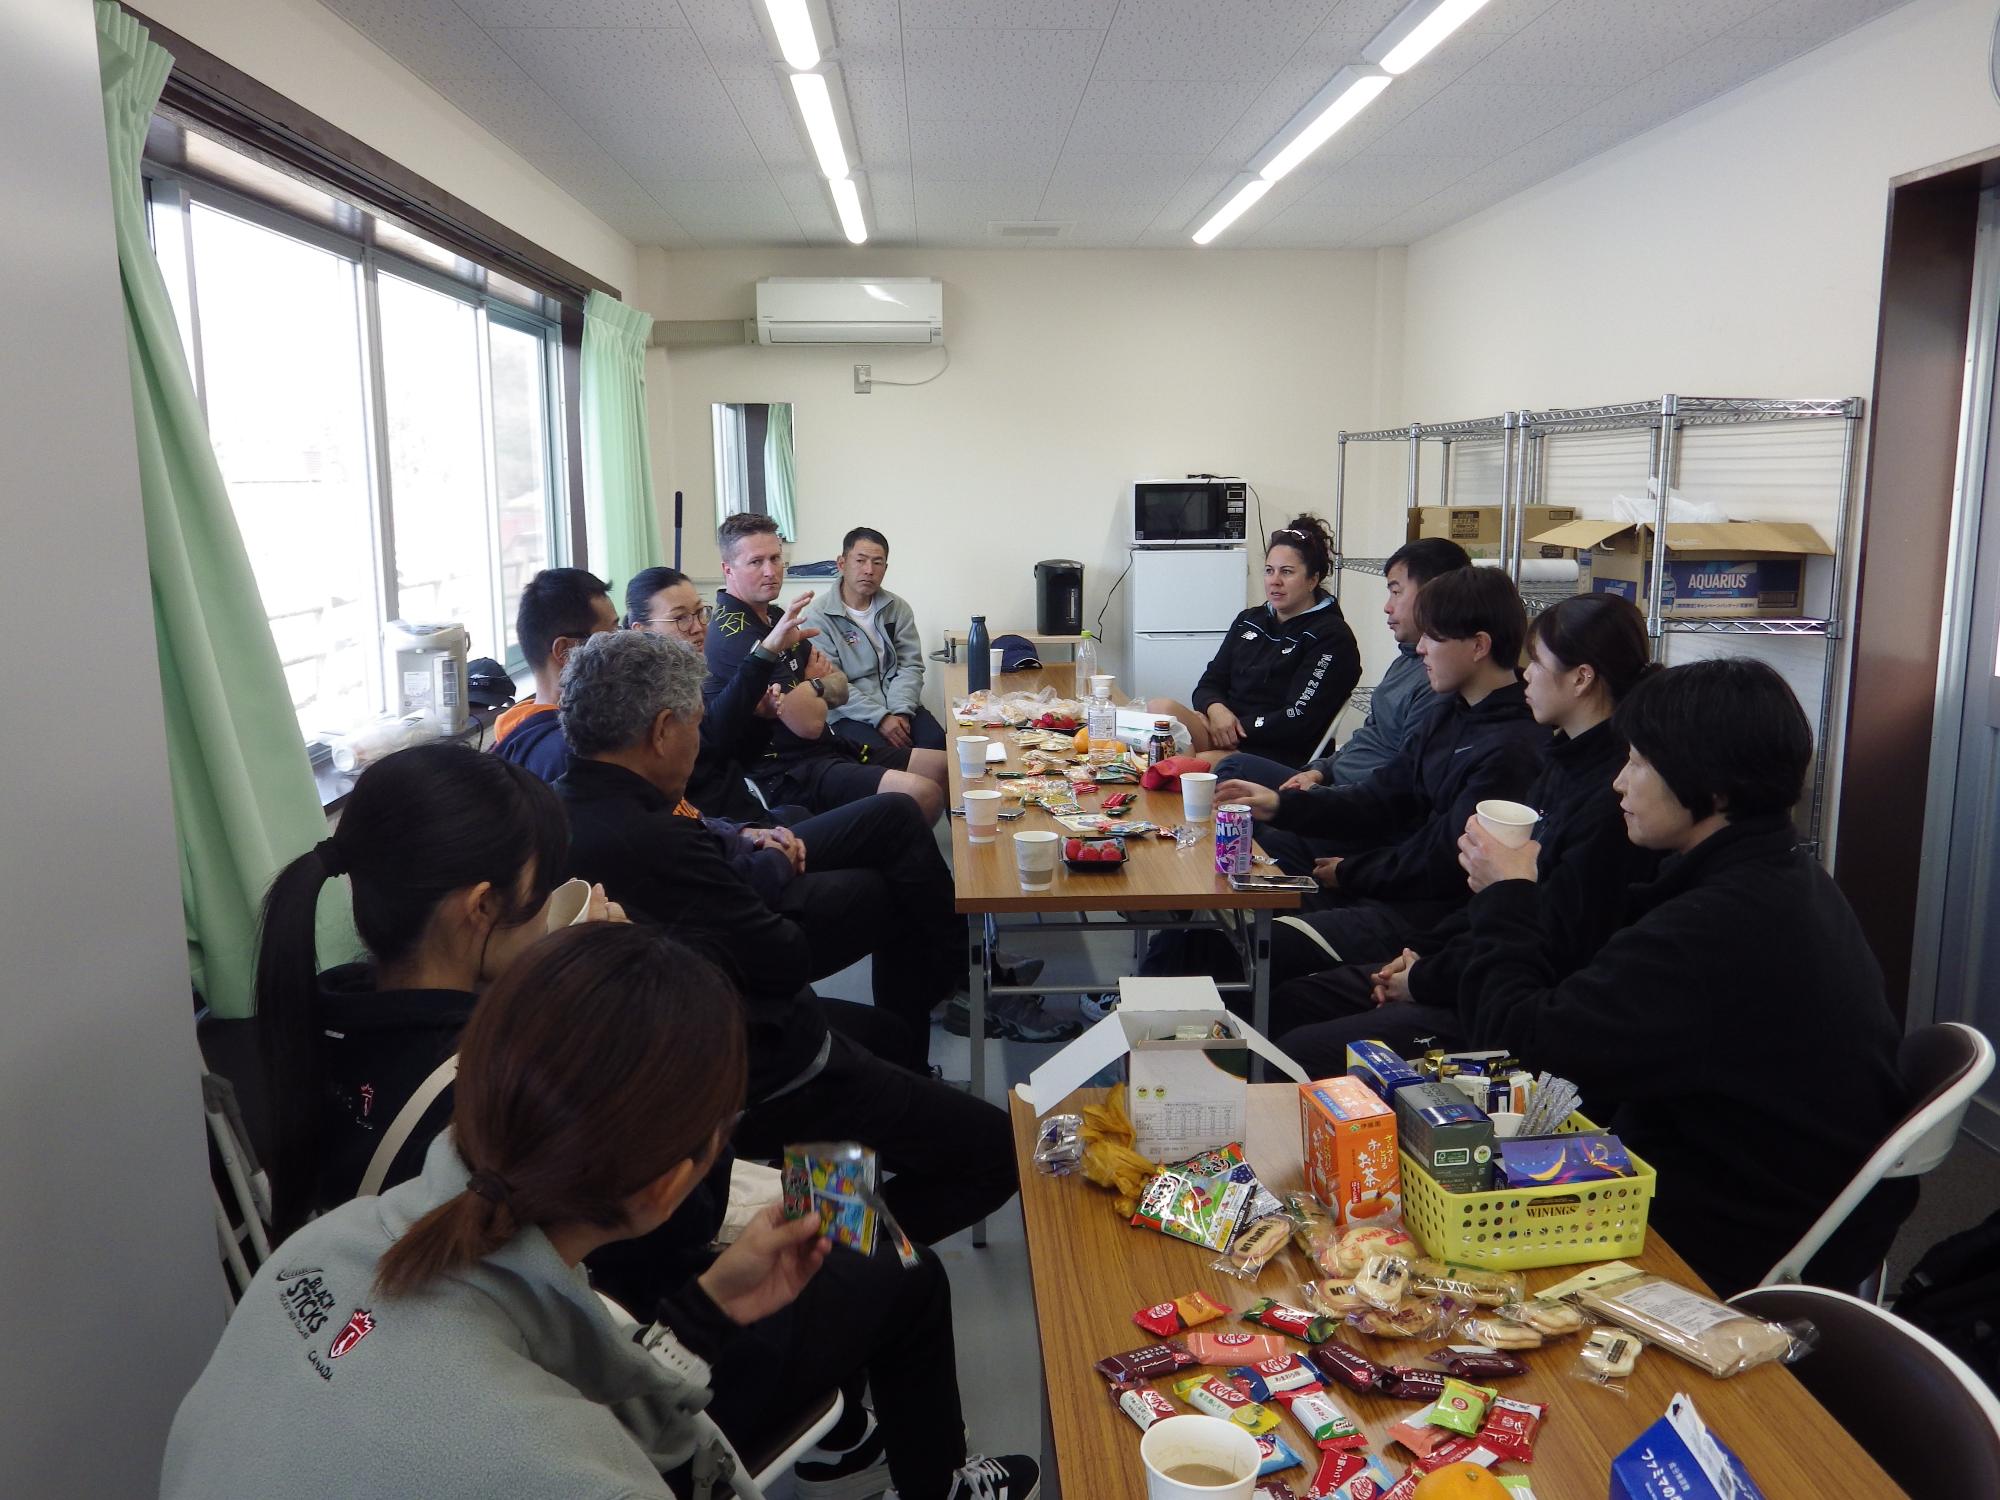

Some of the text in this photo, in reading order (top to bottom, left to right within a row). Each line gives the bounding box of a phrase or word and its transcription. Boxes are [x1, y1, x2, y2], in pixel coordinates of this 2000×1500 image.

[1688, 573, 1748, 589] AQUARIUS
[1286, 653, 1333, 718] NEW ZEALD
[287, 1277, 329, 1334] STICKS
[309, 1277, 335, 1311] BLACK
[1260, 1355, 1292, 1373] KitKat
[1210, 1383, 1245, 1402] KitKat
